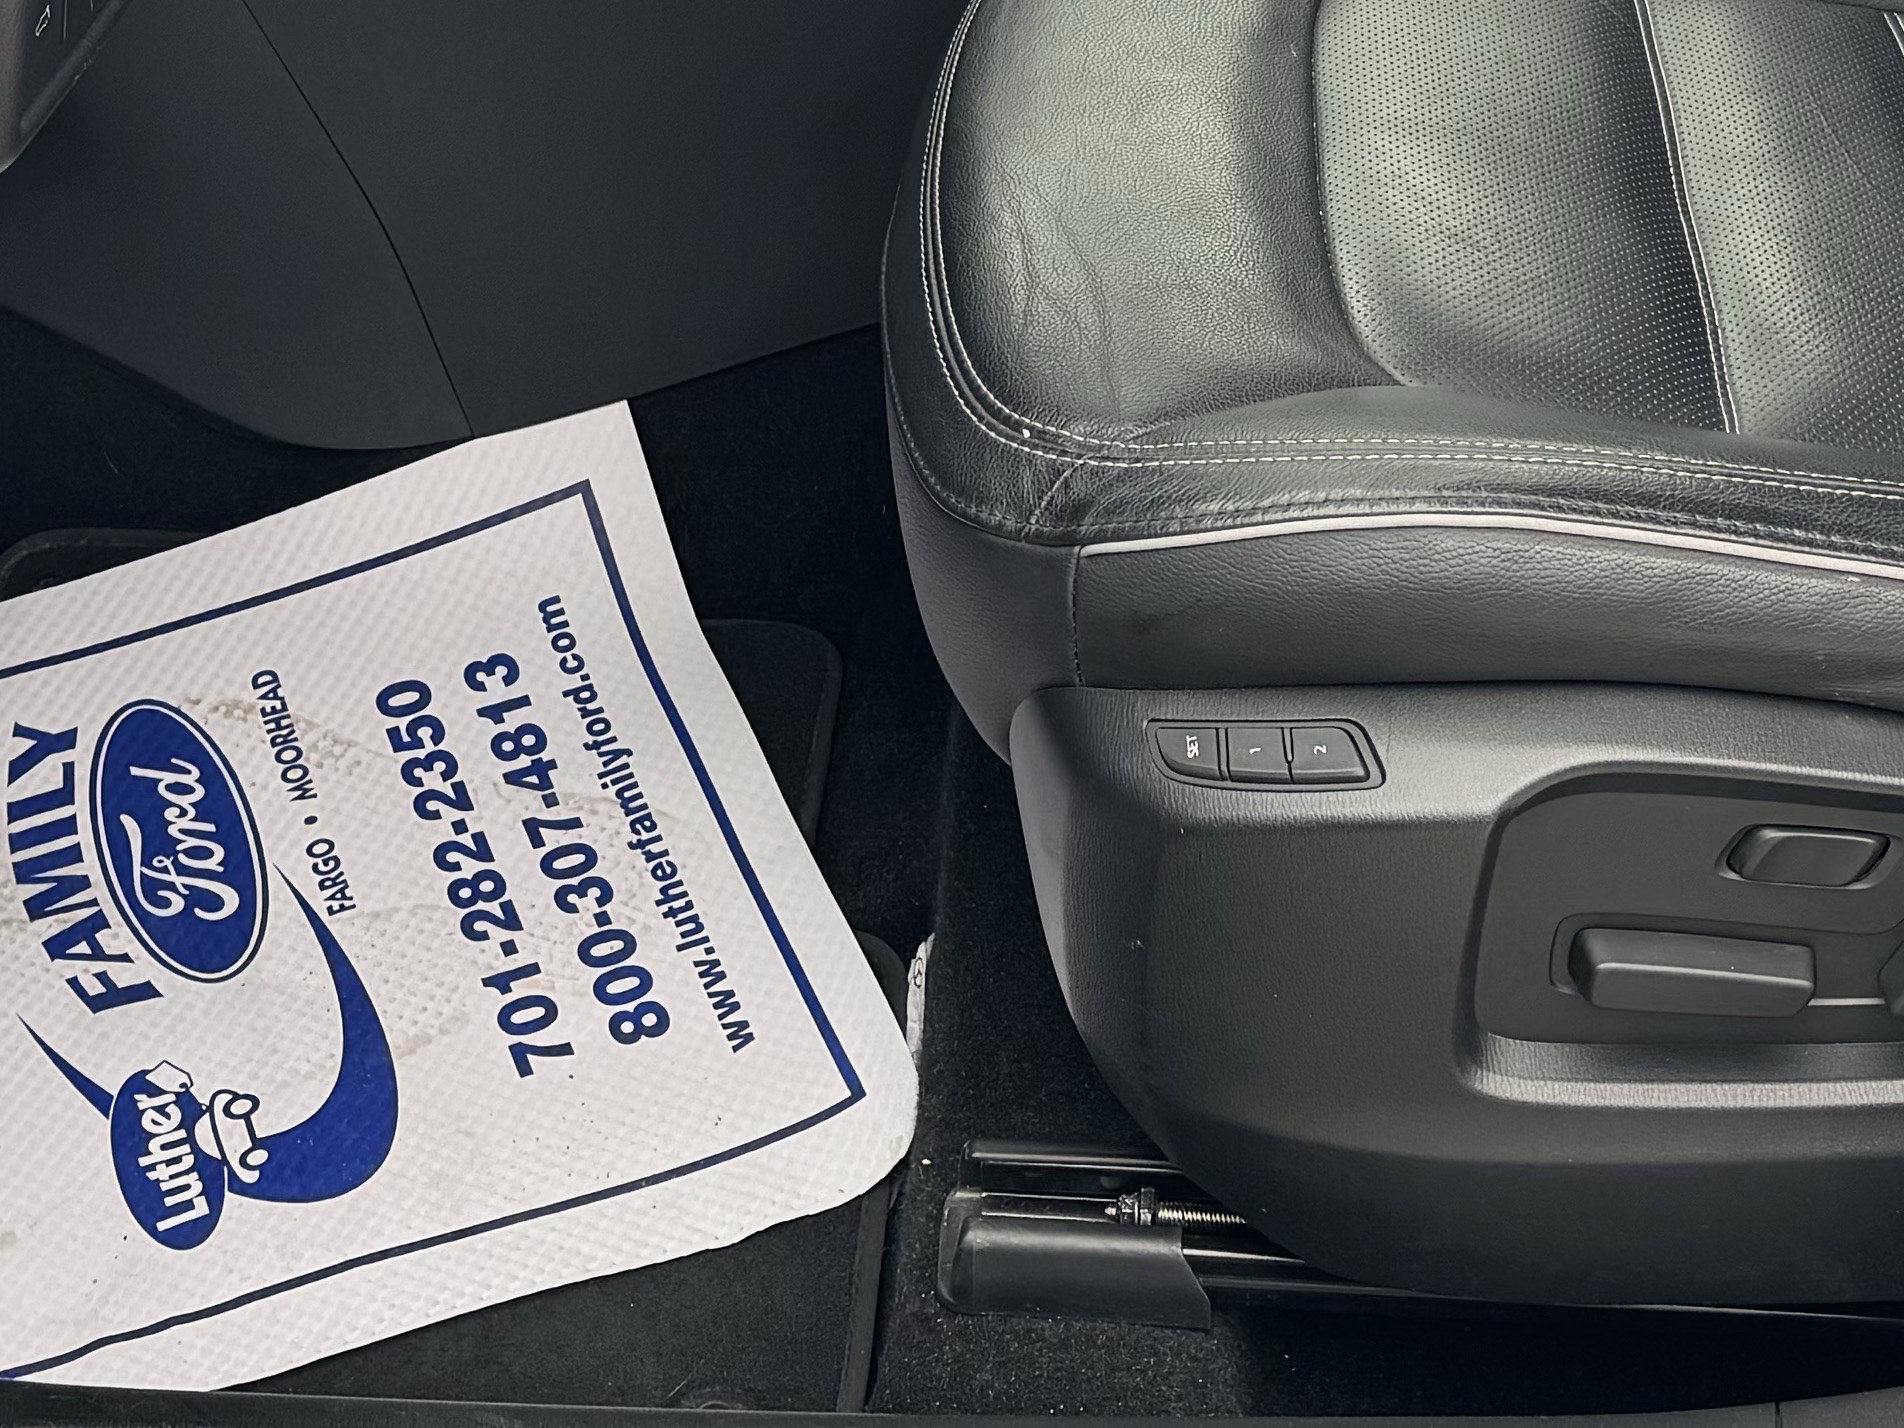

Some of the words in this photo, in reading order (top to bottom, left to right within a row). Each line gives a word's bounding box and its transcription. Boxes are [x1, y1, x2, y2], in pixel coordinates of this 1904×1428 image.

[251, 669, 318, 802] MOORHEAD
[1186, 735, 1199, 759] SET
[1313, 744, 1327, 755] 2
[7, 721, 165, 1015] FAMILY
[119, 758, 241, 922] Ford
[306, 837, 357, 916] FARGO
[375, 679, 576, 1079] 701-282-2350
[464, 652, 671, 1045] 800-307-4813
[537, 594, 756, 1054] www.lutherfamilyford.com
[134, 1092, 210, 1232] Luther
